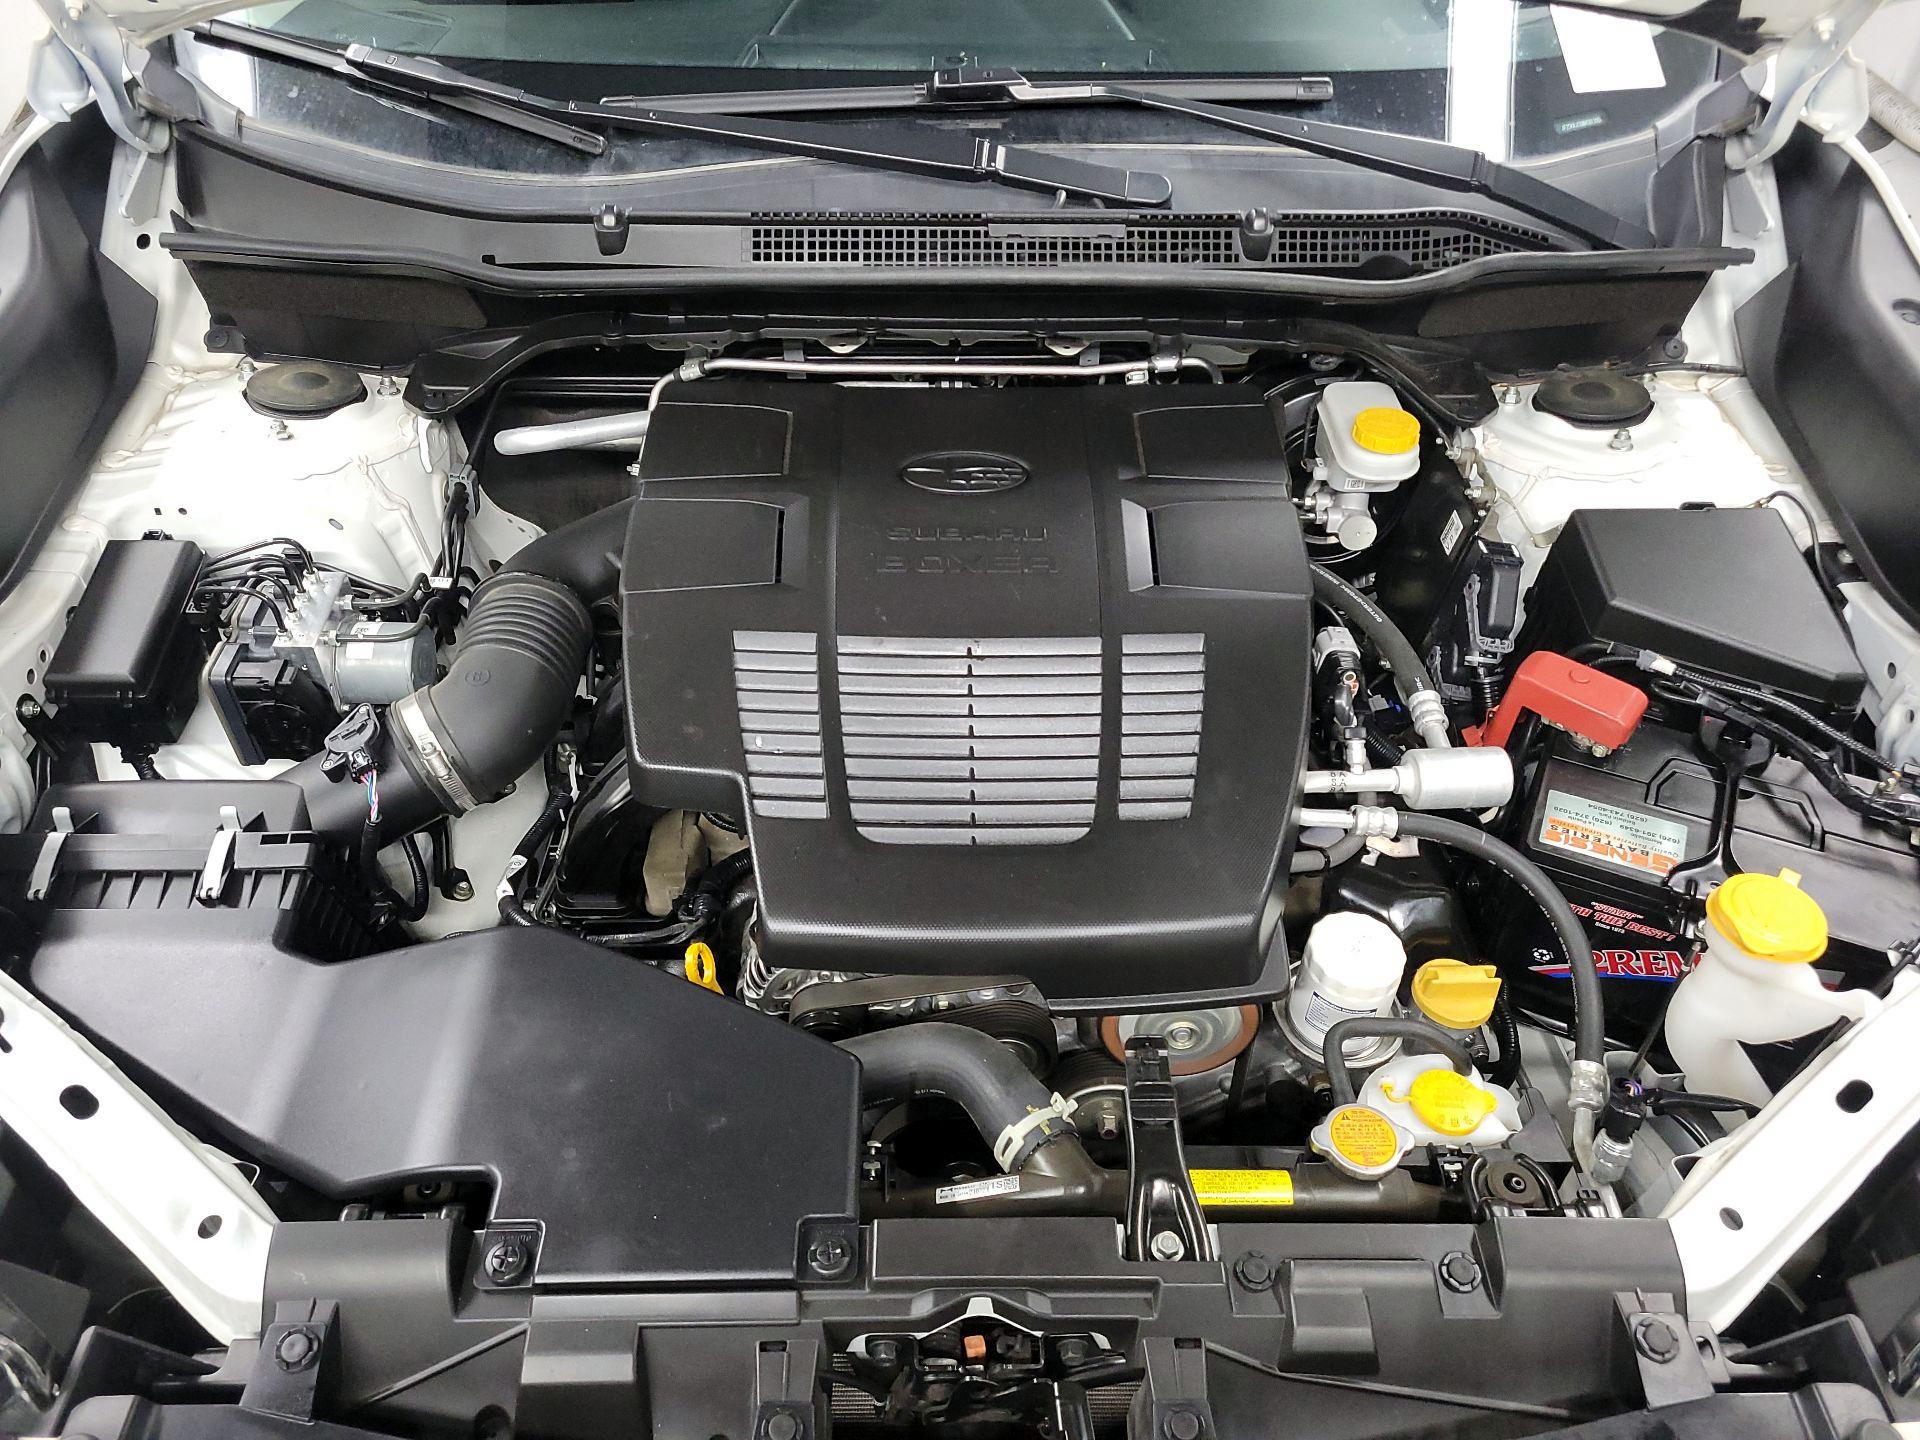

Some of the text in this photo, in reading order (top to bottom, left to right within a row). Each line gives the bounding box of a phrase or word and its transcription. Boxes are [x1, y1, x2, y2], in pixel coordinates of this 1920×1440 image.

[887, 527, 1048, 541] SUBARU
[877, 556, 1059, 573] BOXER
[1550, 824, 1650, 856] BATTERIES
[1569, 903, 1593, 917] TH
[1594, 911, 1627, 927] THE
